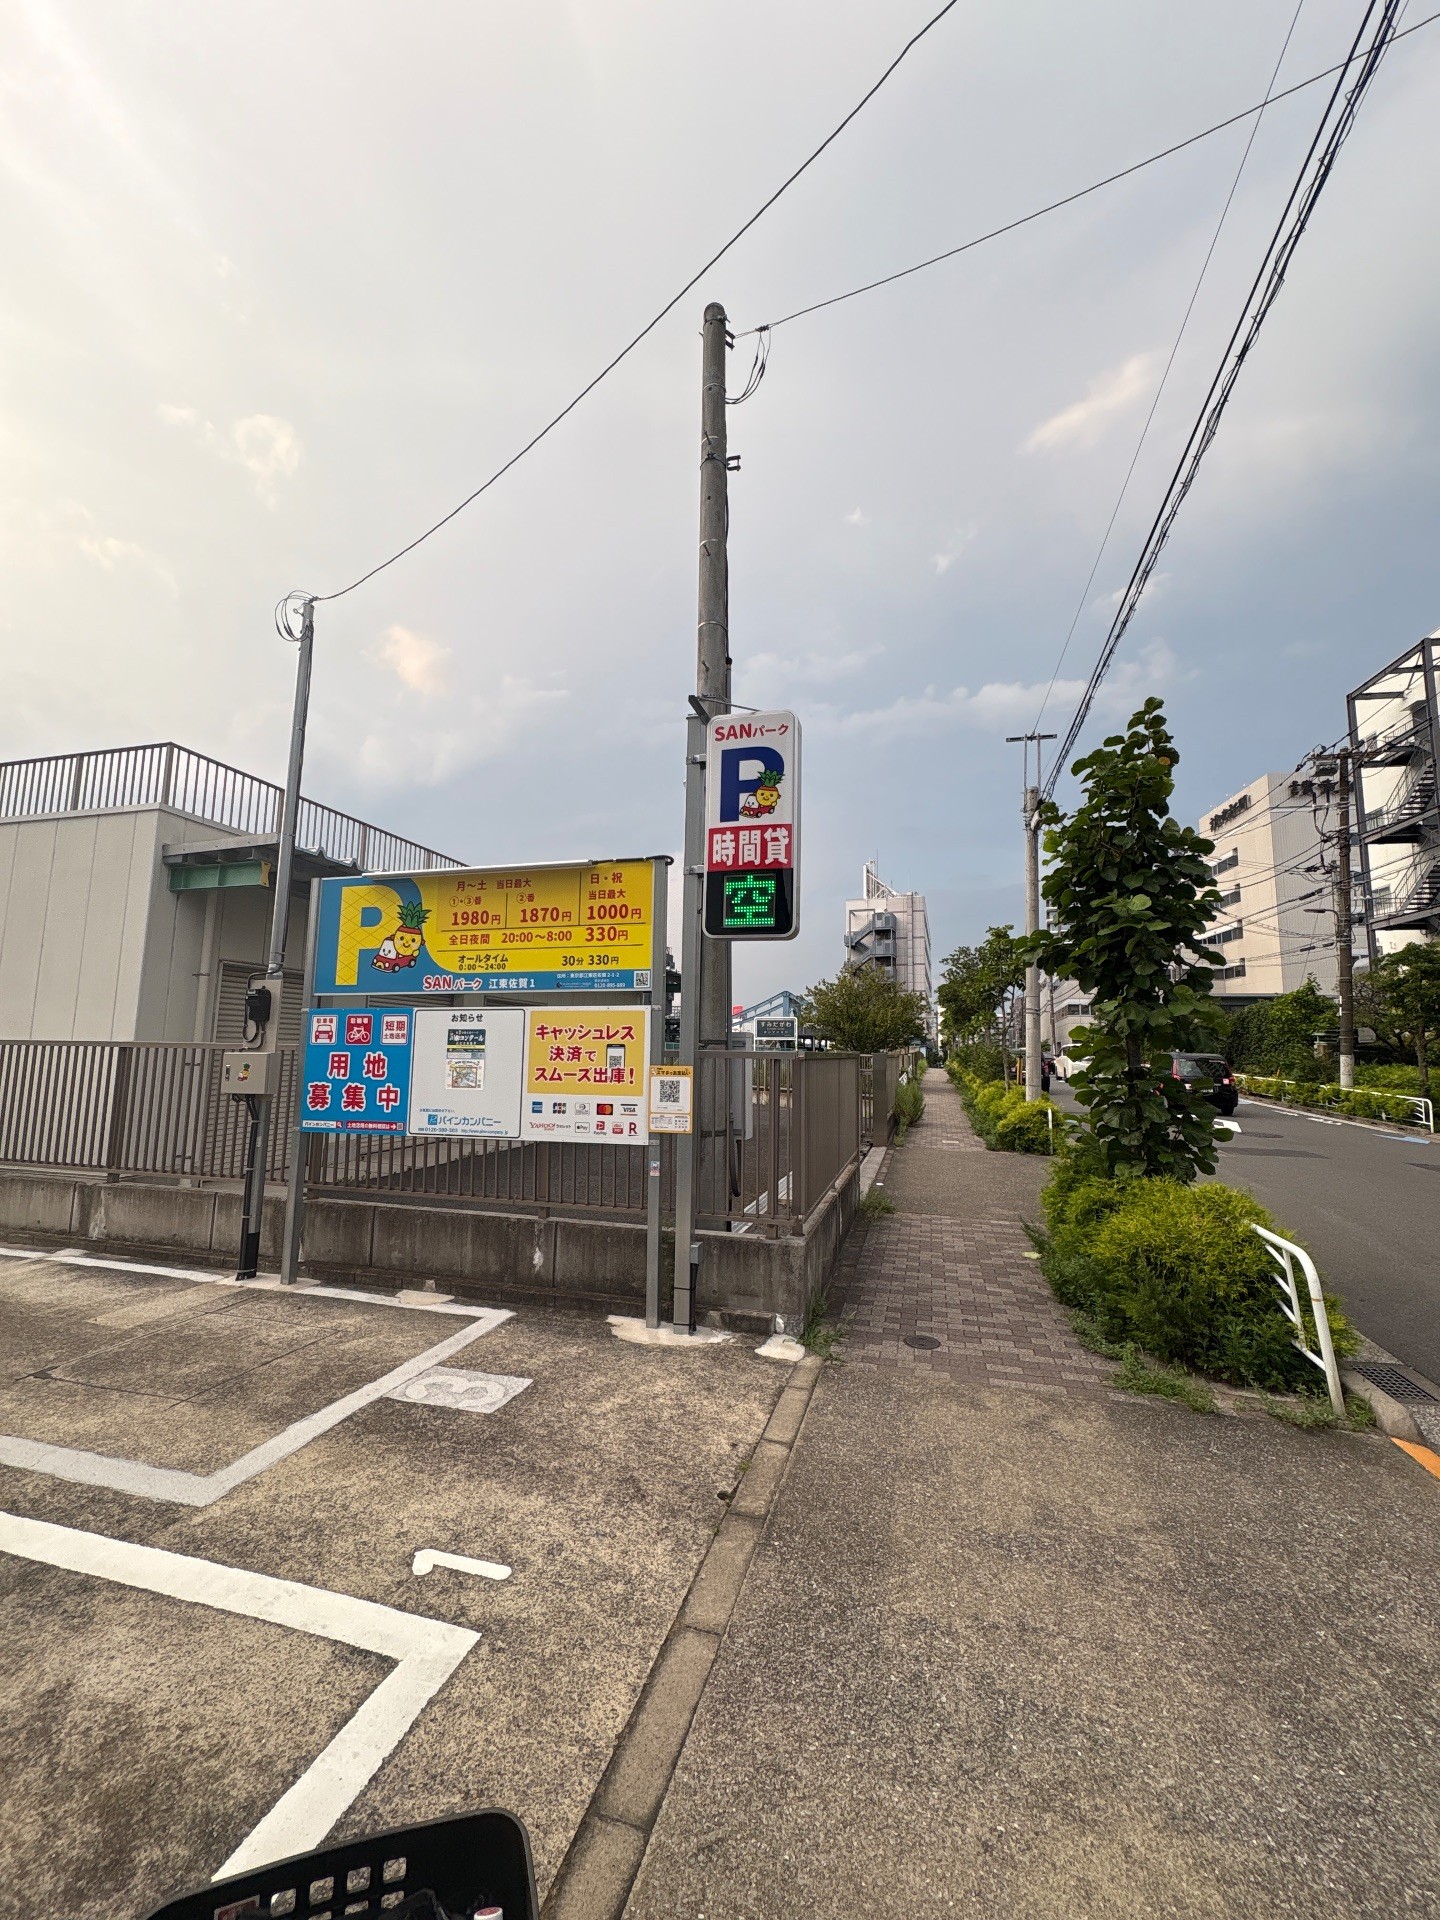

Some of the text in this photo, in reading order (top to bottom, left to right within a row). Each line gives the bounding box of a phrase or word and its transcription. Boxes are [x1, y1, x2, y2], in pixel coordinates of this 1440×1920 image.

[714, 723, 789, 742] SANパーク
[720, 746, 785, 823] P
[712, 827, 789, 866] 時間貸
[496, 878, 532, 889] 当日最大
[590, 872, 623, 885] 日・祝
[588, 888, 626, 900] 当日最大
[725, 875, 776, 925] 空
[451, 910, 501, 926] 1980円
[520, 907, 572, 923] 1870円
[587, 904, 642, 920] 1000円
[335, 884, 405, 986] P
[449, 933, 490, 945] 全日夜間
[585, 926, 629, 942] 330円
[457, 953, 619, 967] オールタイム 30分 330円
[423, 974, 483, 991] SANパーク
[451, 1013, 483, 1022] お知らせ
[385, 1020, 406, 1032] 短期
[536, 1024, 635, 1040] キャッシュレス
[549, 1045, 597, 1062] 決済で
[328, 1052, 387, 1079] 用地
[308, 1083, 399, 1111] 募集中
[438, 1116, 501, 1126] パインカンパニー
[412, 1548, 512, 1581] 1
